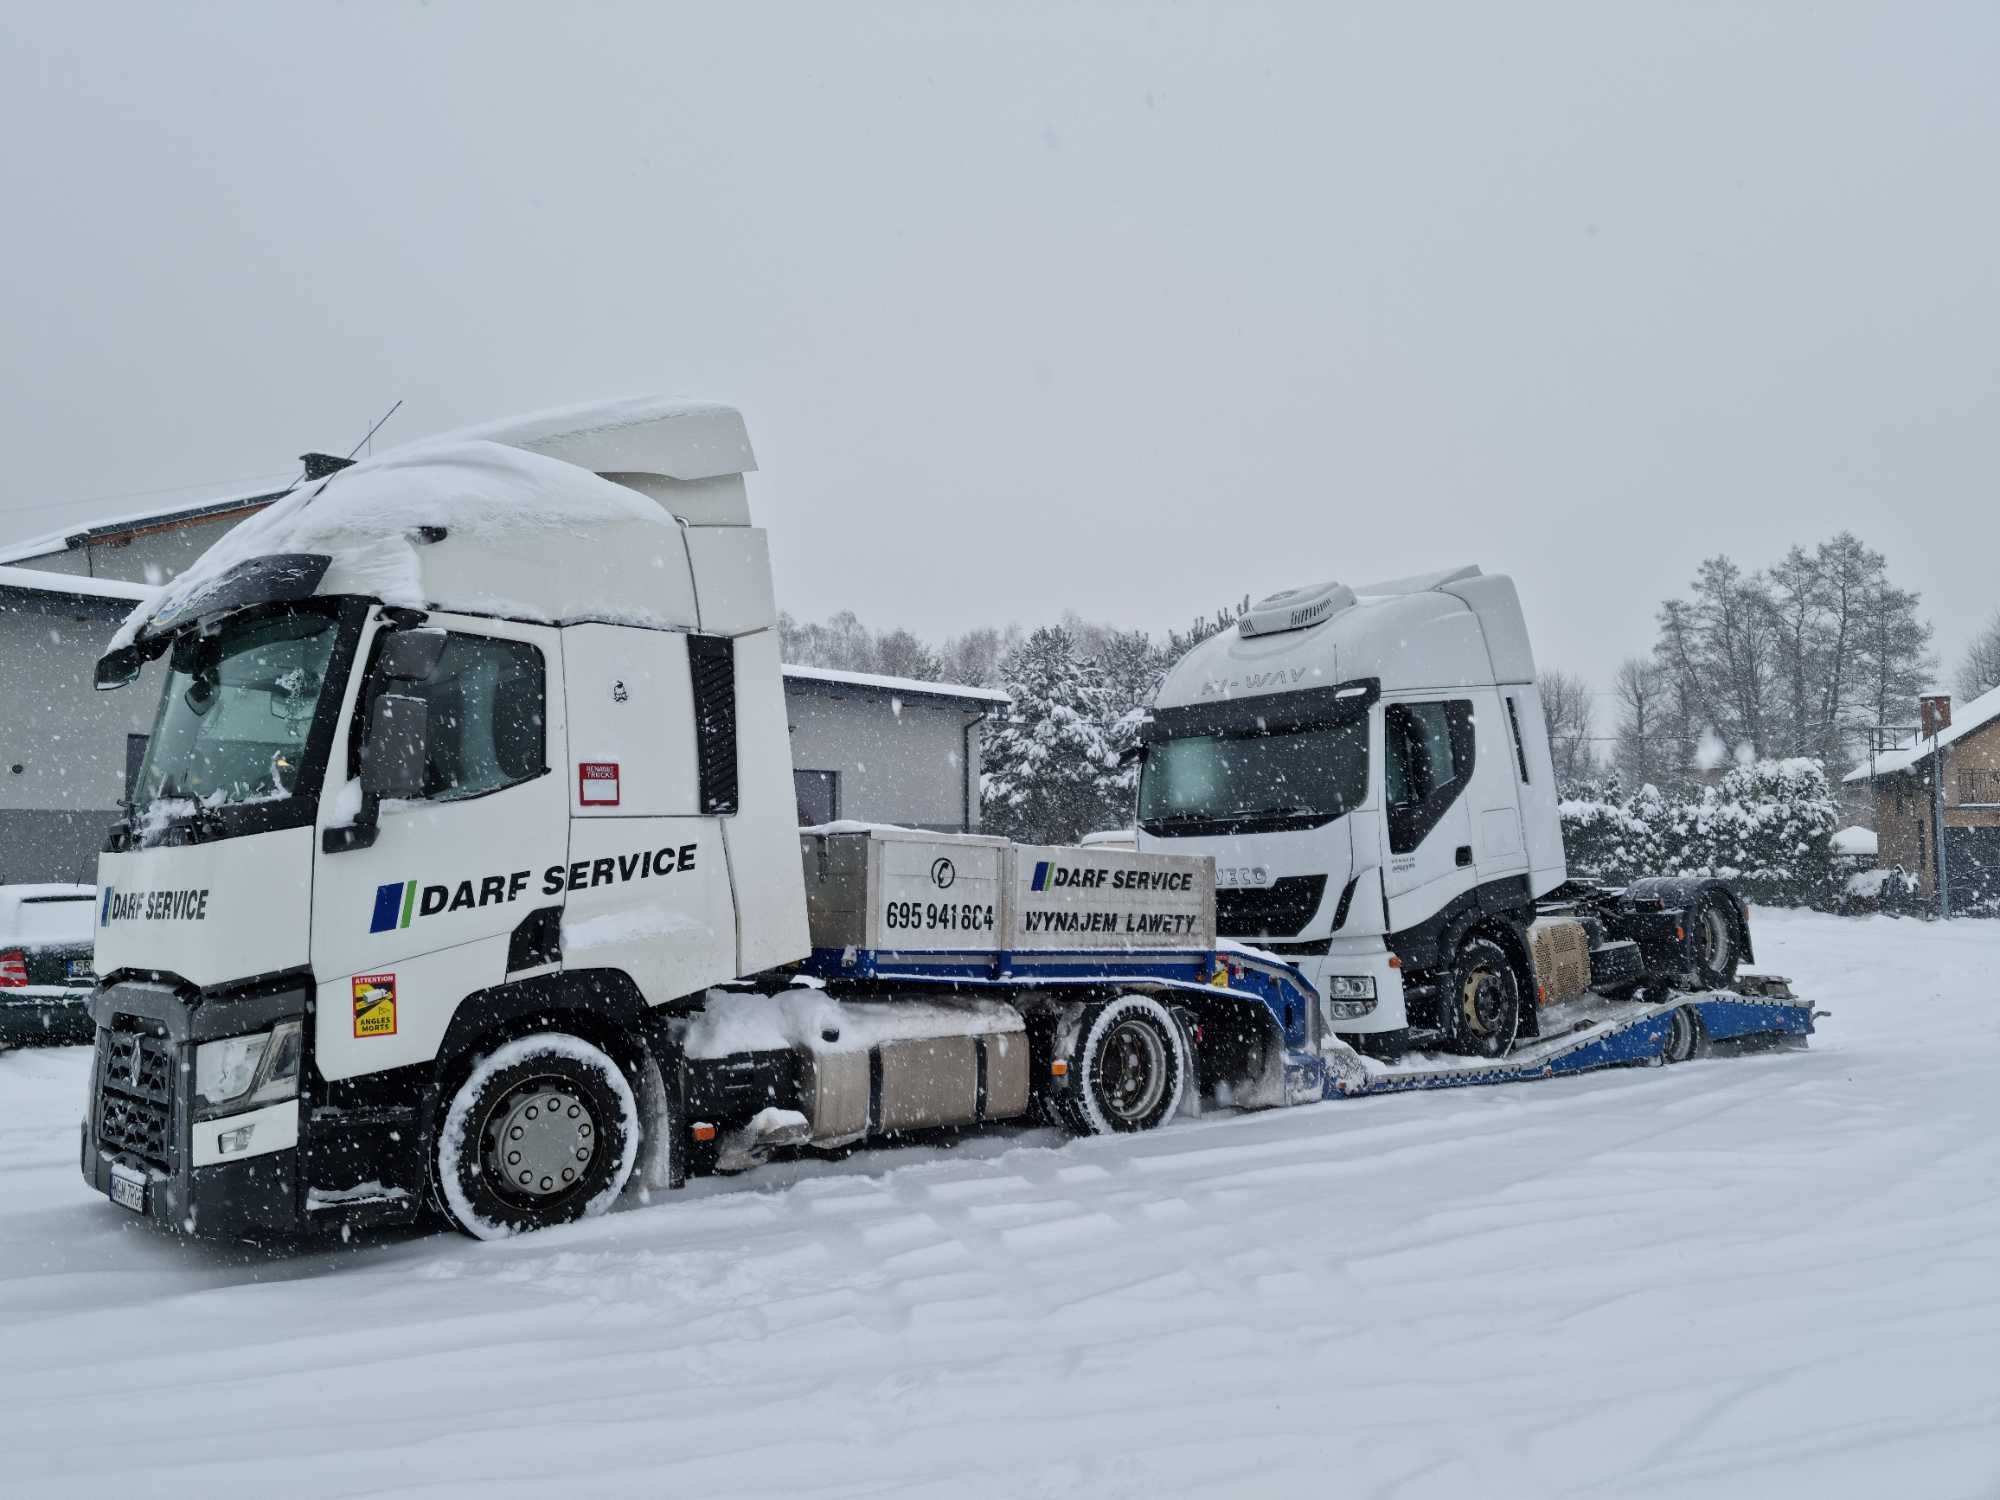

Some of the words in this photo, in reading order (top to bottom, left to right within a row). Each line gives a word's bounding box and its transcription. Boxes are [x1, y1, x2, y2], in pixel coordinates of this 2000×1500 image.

[419, 870, 531, 917] DARF
[541, 843, 698, 896] SERVICE
[1054, 868, 1109, 887] DARF
[1112, 870, 1193, 892] SERVICE
[1215, 867, 1266, 885] VECO
[111, 892, 144, 920] DARF
[145, 889, 209, 920] SERVICE
[887, 901, 922, 929] 695
[926, 903, 957, 930] 941
[1025, 911, 1118, 932] WYNAJEM
[1126, 913, 1197, 934] LAWETY
[355, 975, 394, 984] ATTENTION
[360, 1016, 391, 1025] ANGLES
[361, 1023, 390, 1032] MORTS
